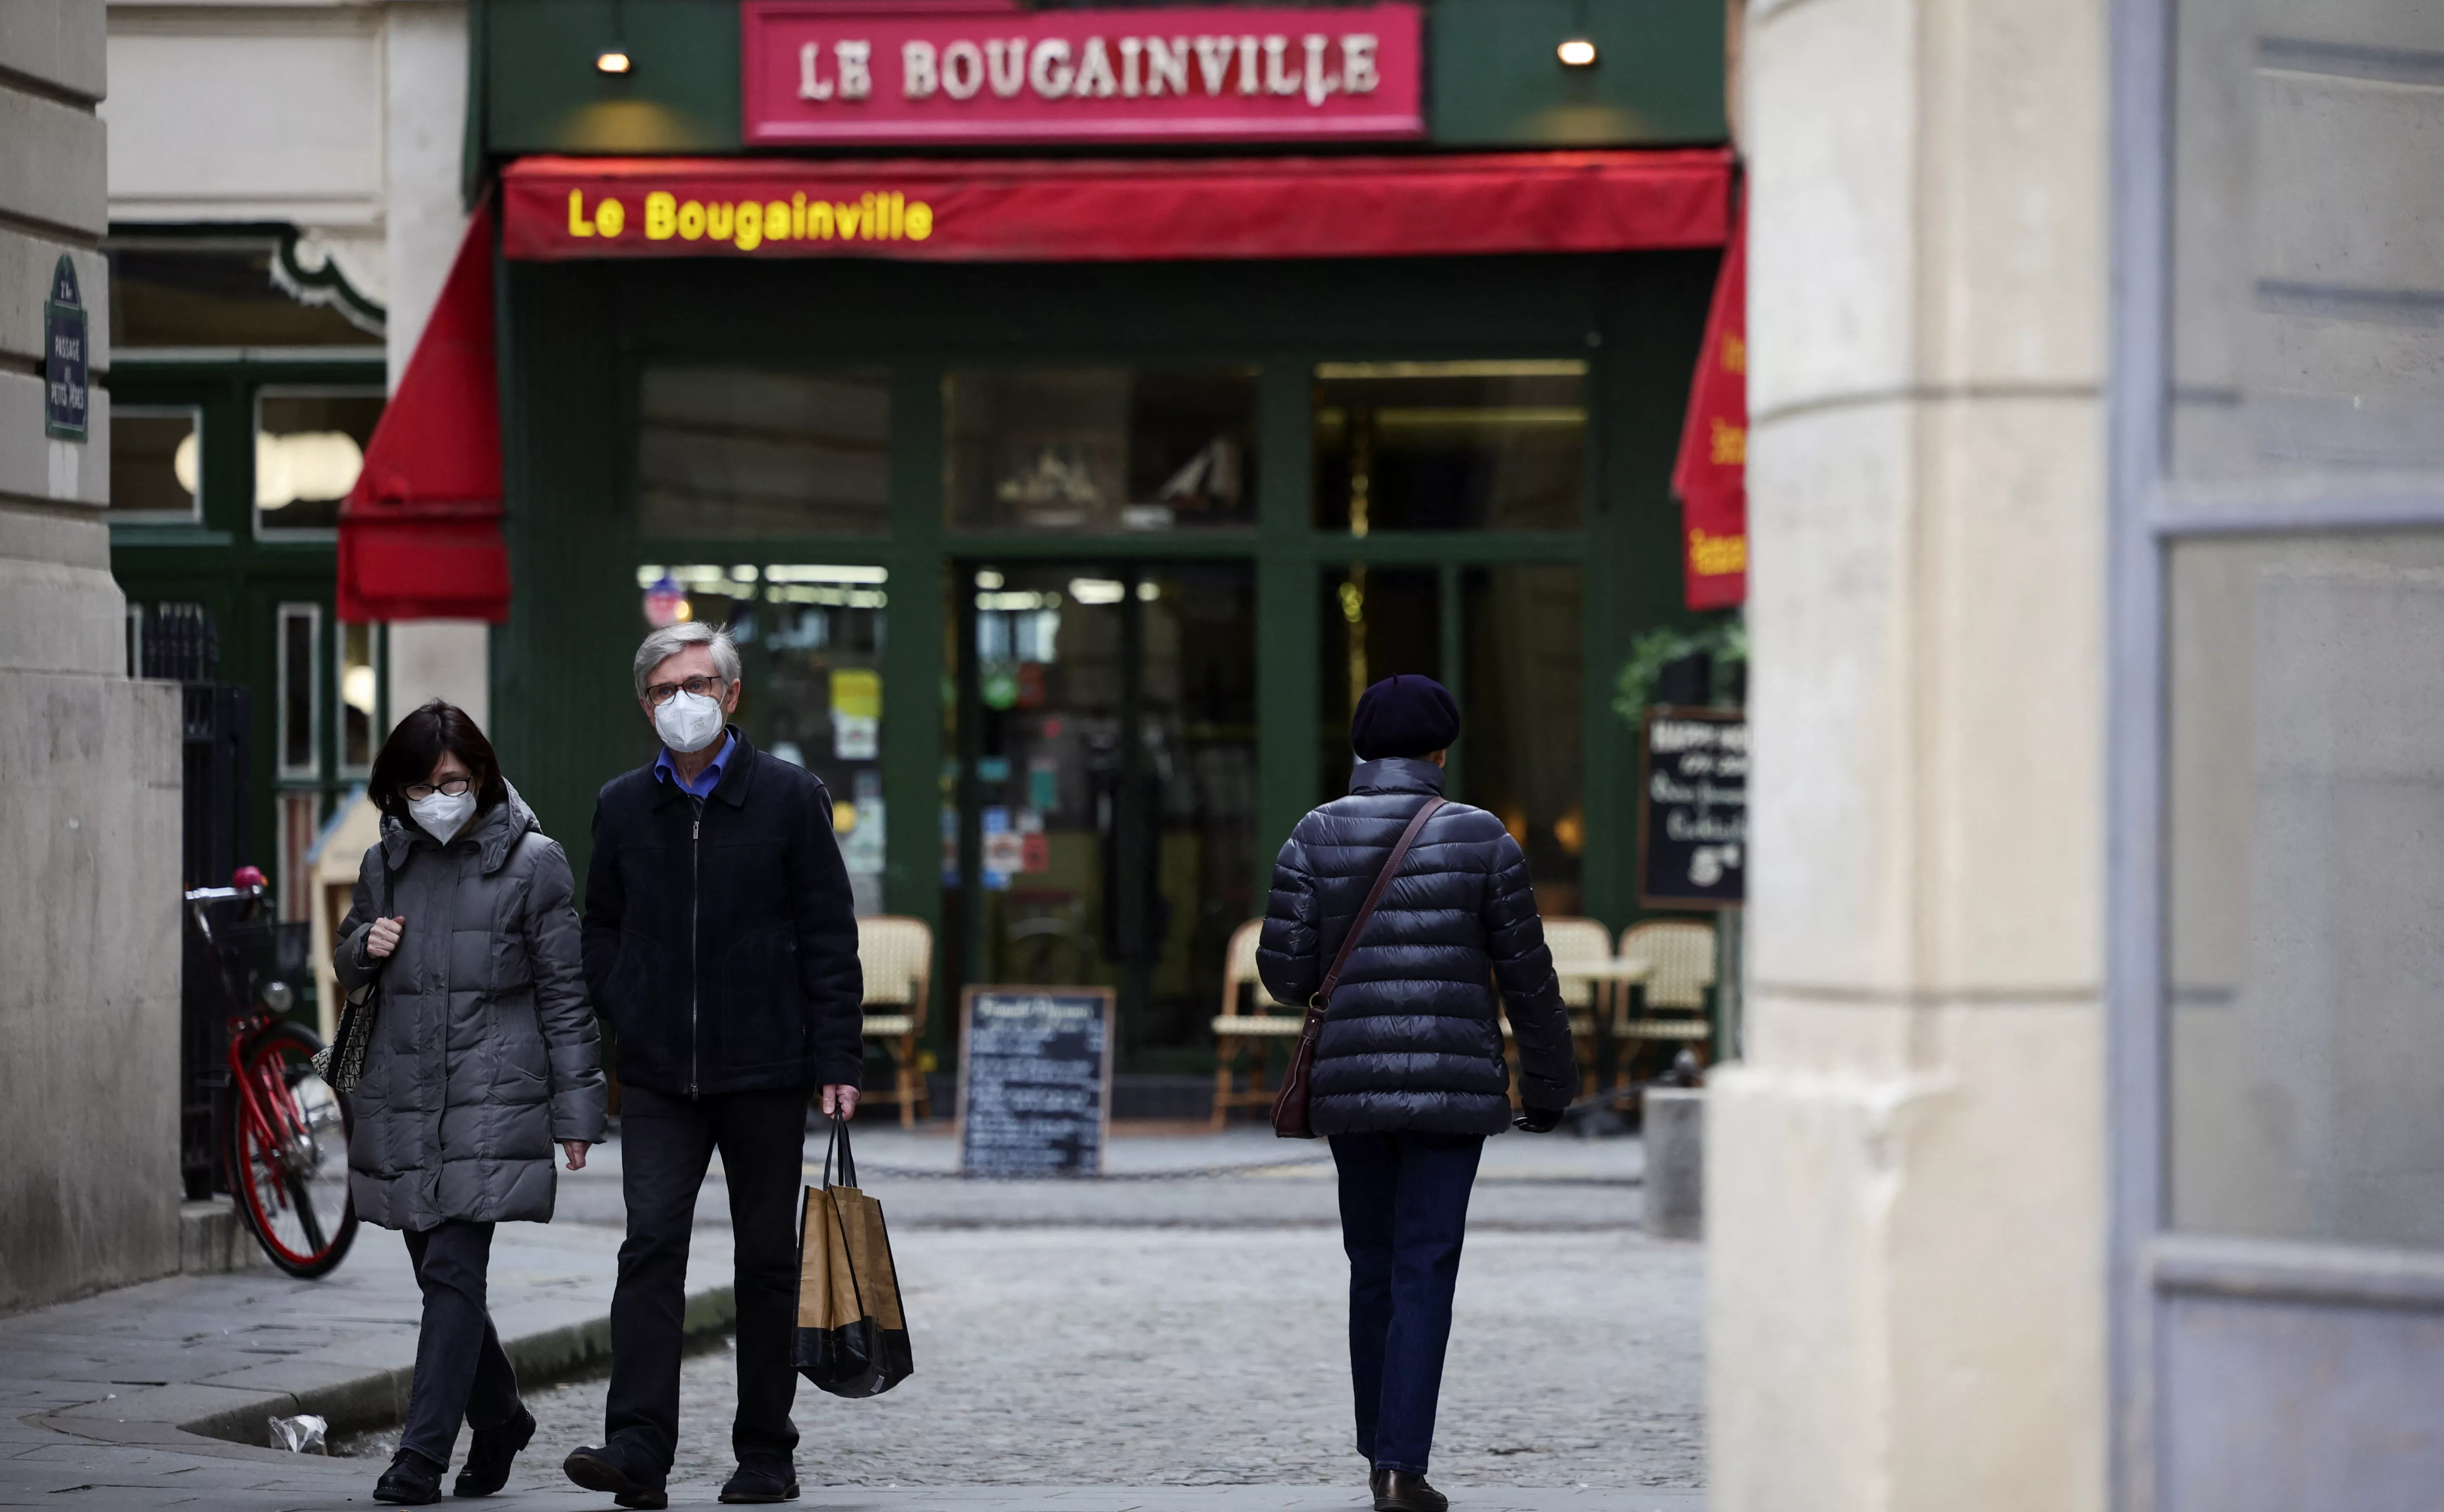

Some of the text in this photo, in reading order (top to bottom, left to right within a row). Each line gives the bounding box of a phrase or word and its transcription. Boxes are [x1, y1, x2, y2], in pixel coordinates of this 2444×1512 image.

[798, 34, 1379, 107] LE BOUGAINVILLE
[568, 187, 933, 251] Le Bougainville
[55, 335, 80, 362] PASSAGE
